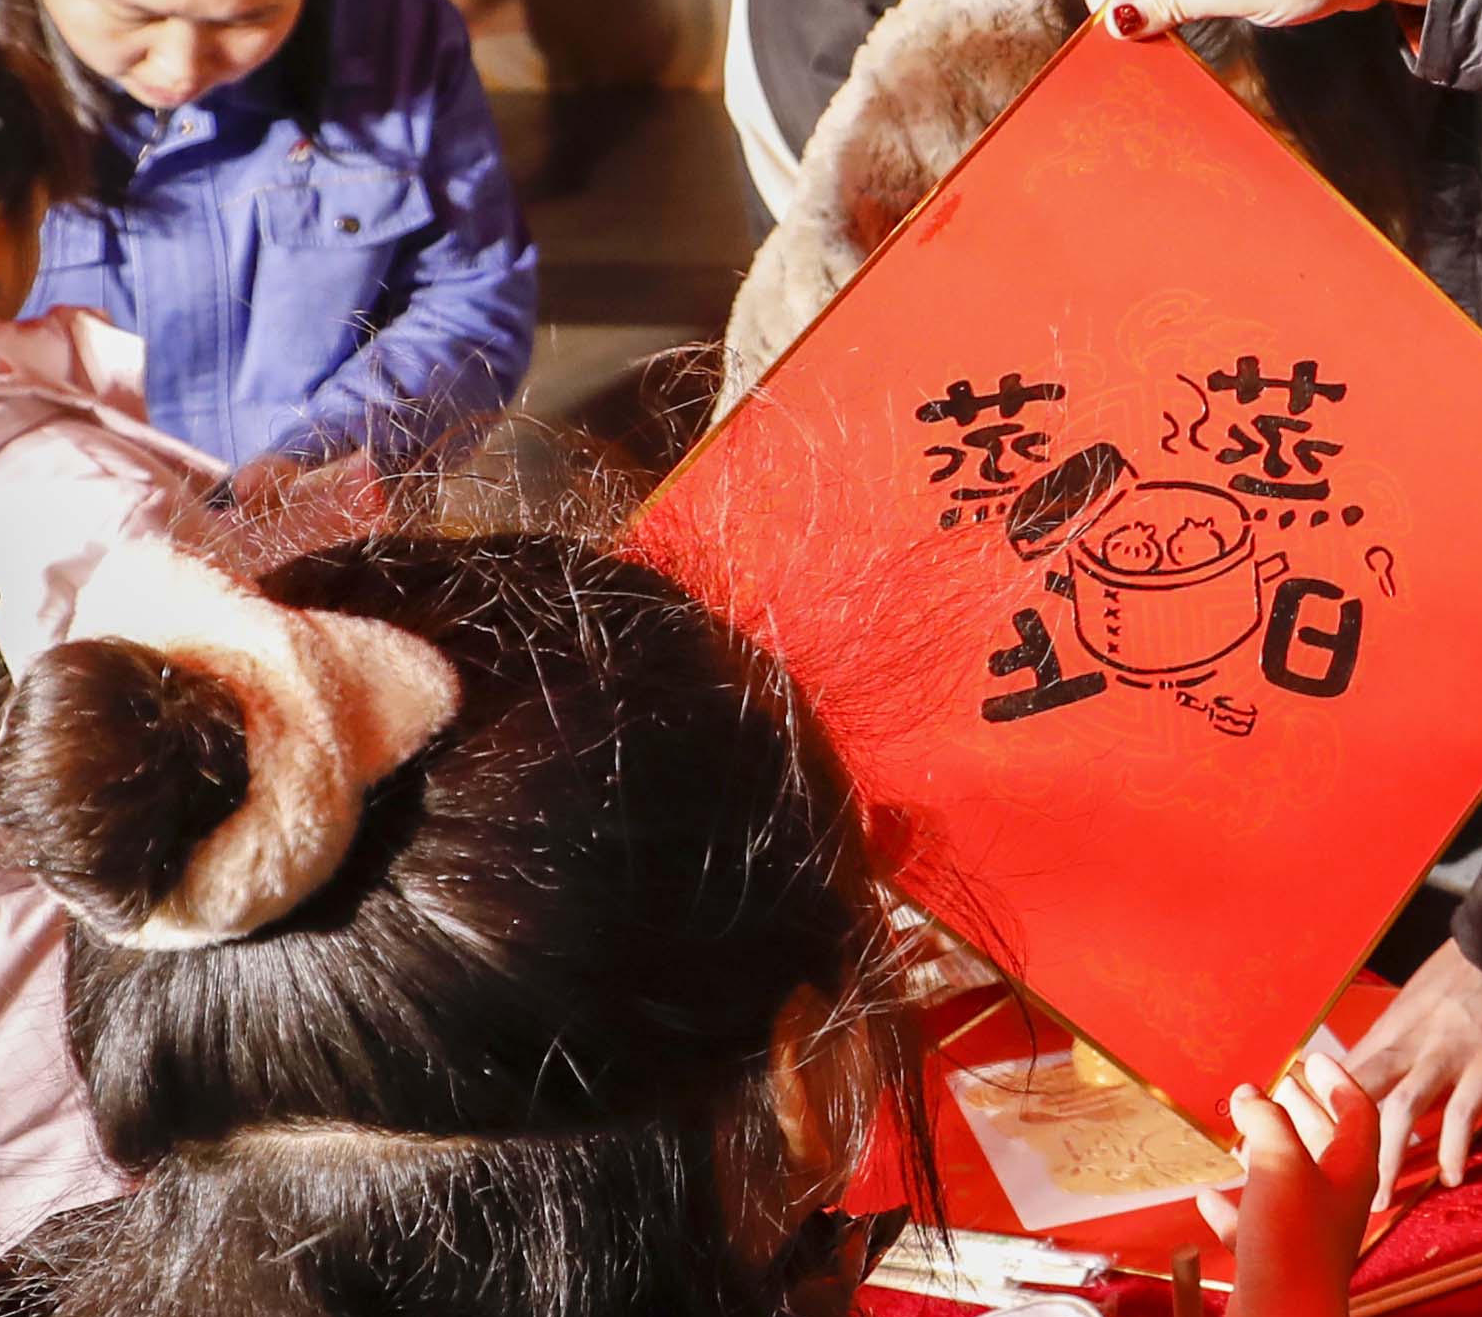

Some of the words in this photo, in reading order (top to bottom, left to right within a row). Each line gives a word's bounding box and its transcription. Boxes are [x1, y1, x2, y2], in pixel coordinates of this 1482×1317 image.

[1208, 355, 1364, 527] 蒸
[981, 607, 1108, 724] 上
[1259, 576, 1363, 697] 日
